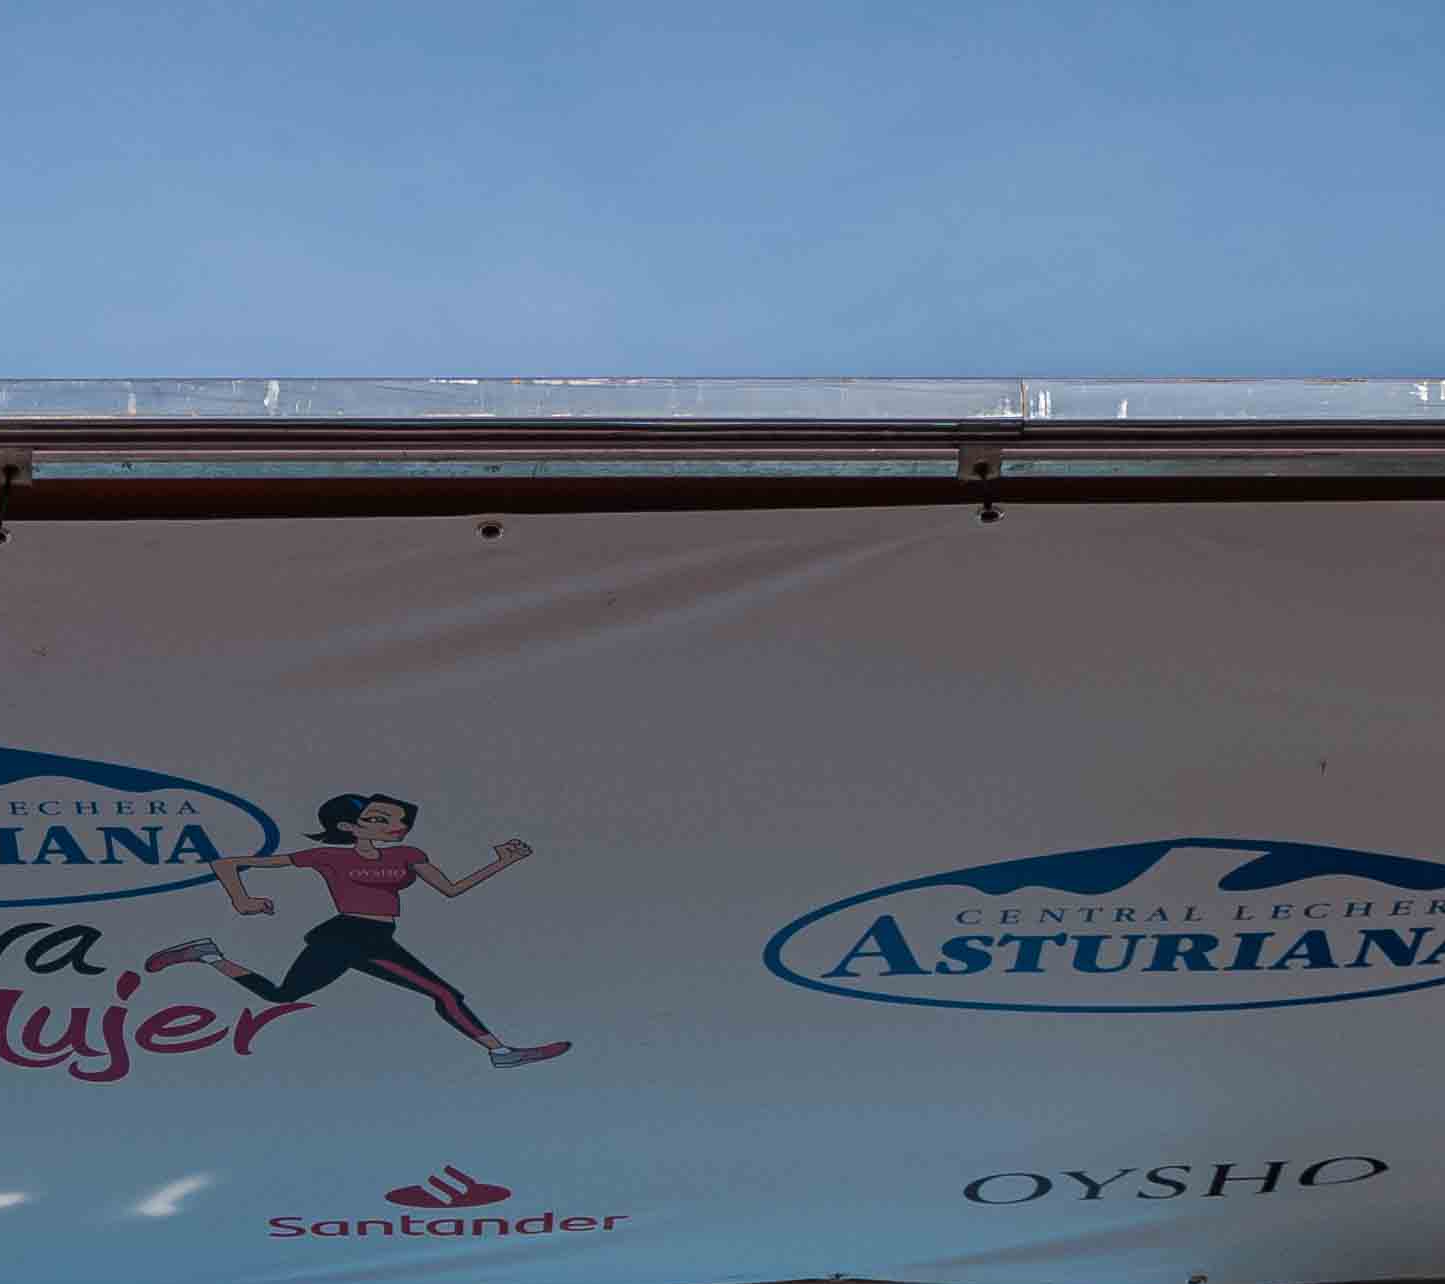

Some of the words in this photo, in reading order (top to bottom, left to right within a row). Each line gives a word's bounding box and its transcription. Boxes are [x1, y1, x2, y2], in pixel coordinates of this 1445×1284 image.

[956, 904, 1203, 926] CENTRAL
[963, 1155, 1389, 1205] OYSHO
[268, 1211, 630, 1238] Santander
